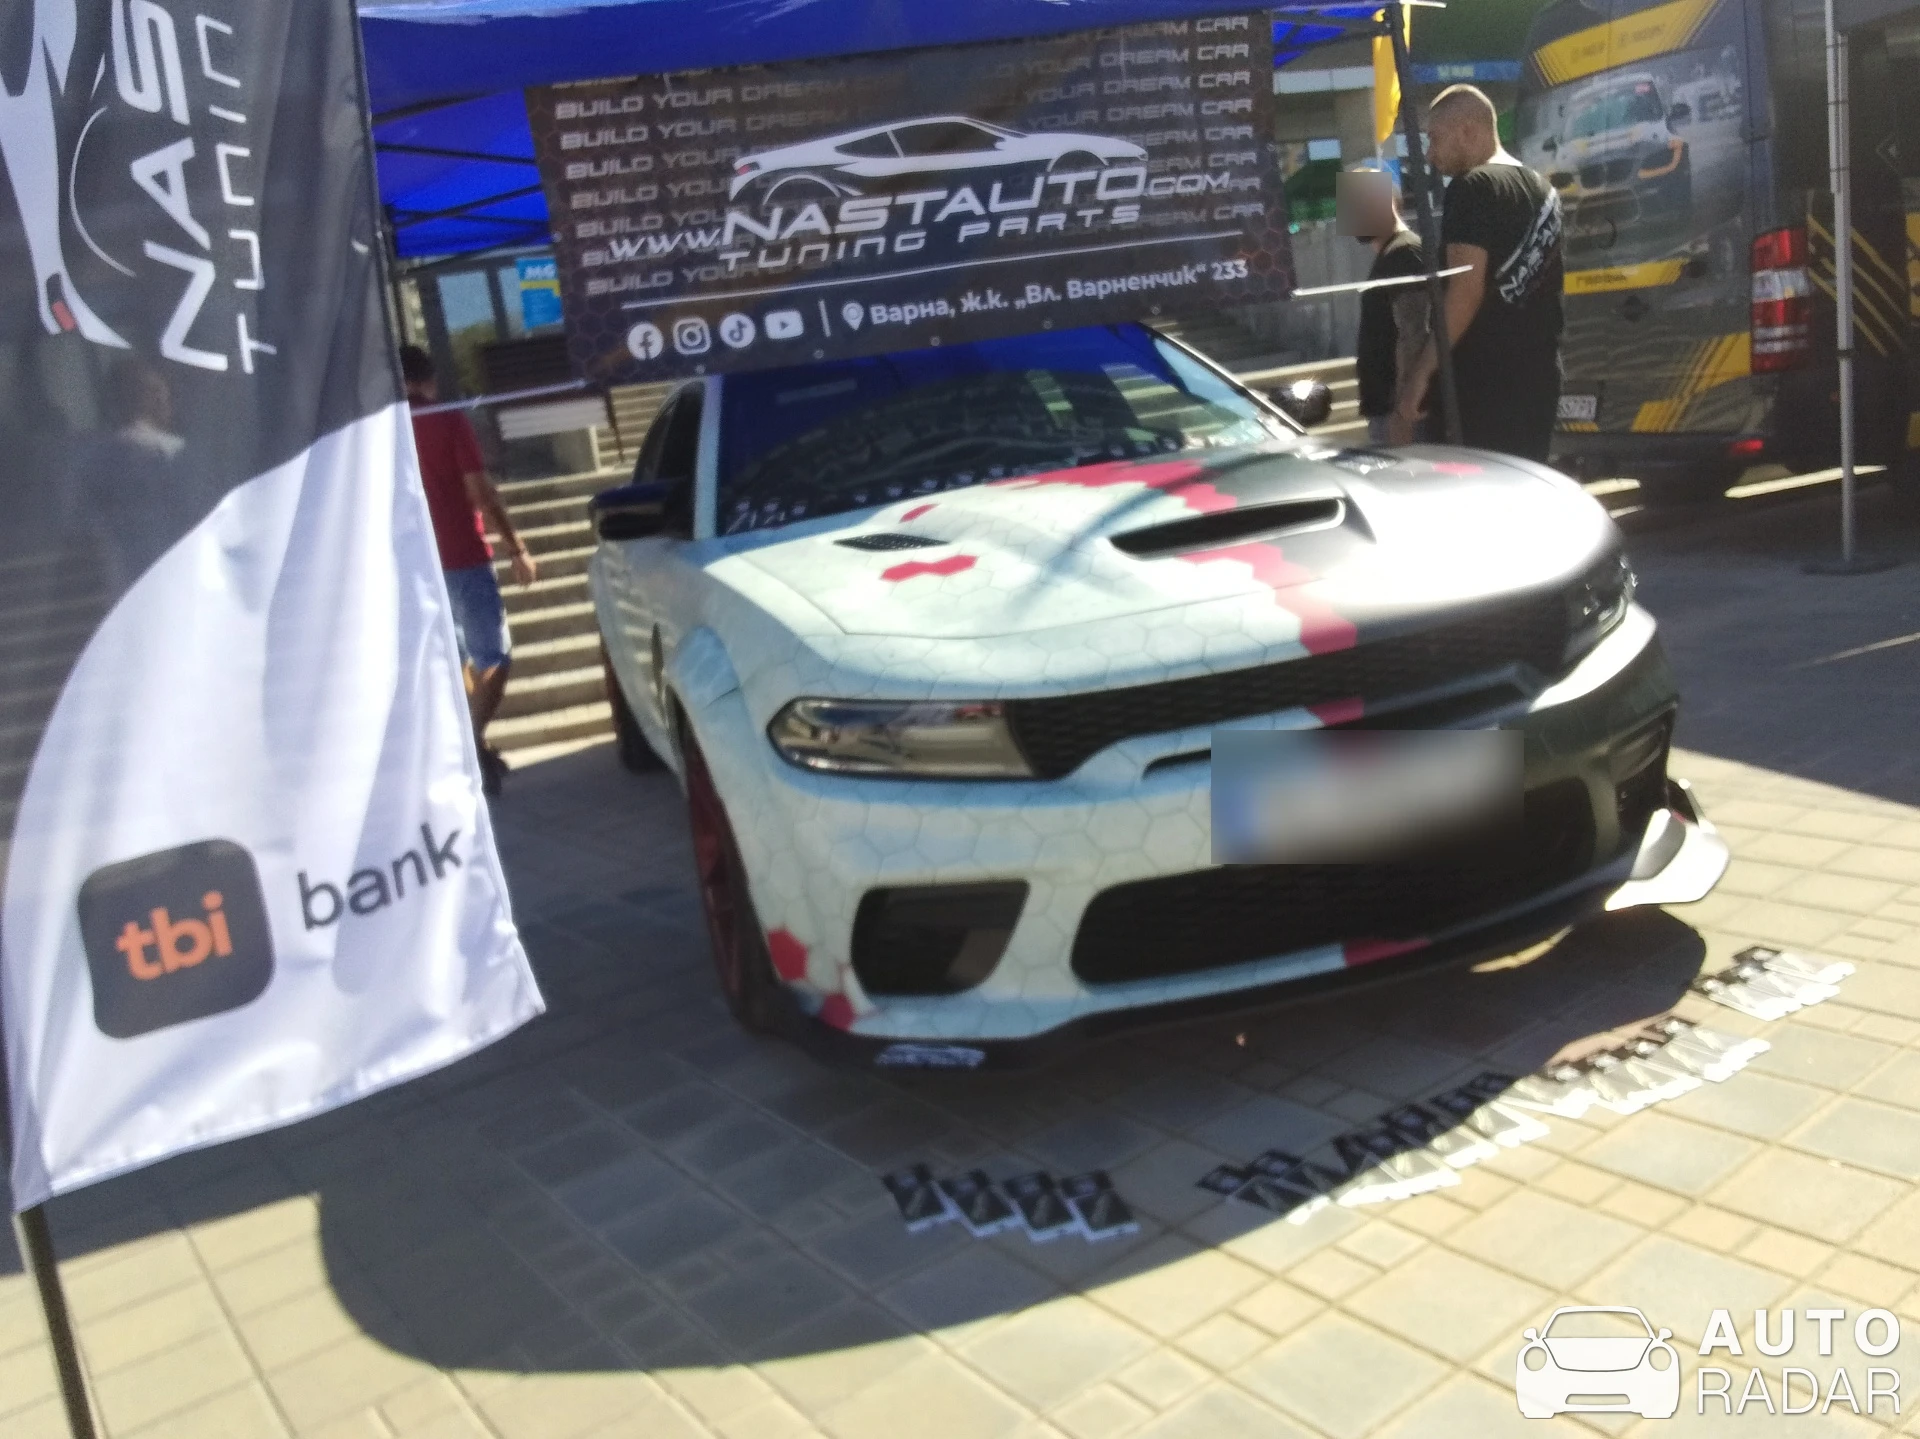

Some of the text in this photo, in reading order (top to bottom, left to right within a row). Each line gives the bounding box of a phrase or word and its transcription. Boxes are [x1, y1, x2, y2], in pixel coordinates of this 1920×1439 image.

[1196, 43, 1250, 61] CAR
[1102, 75, 1192, 95] DREAM
[1198, 71, 1251, 89] CAR
[555, 94, 645, 120] BUILD
[652, 86, 734, 110] YOUR
[1105, 103, 1195, 123] DREAM
[1200, 98, 1253, 115] CAR
[560, 124, 650, 150] BUILD
[656, 118, 737, 140] YOUR
[1121, 125, 1254, 148] REAM CAR
[565, 154, 655, 180] BUILD
[1208, 151, 1258, 168] CAR
[571, 178, 730, 210] BUILD YOU
[957, 203, 1141, 243] PARTS
[1213, 202, 1265, 221] CAR
[576, 213, 665, 239] BUILD
[586, 269, 674, 297] BUILD
[869, 298, 956, 325] Варна,
[1210, 259, 1250, 282] 233
[115, 822, 465, 982] tbi bank
